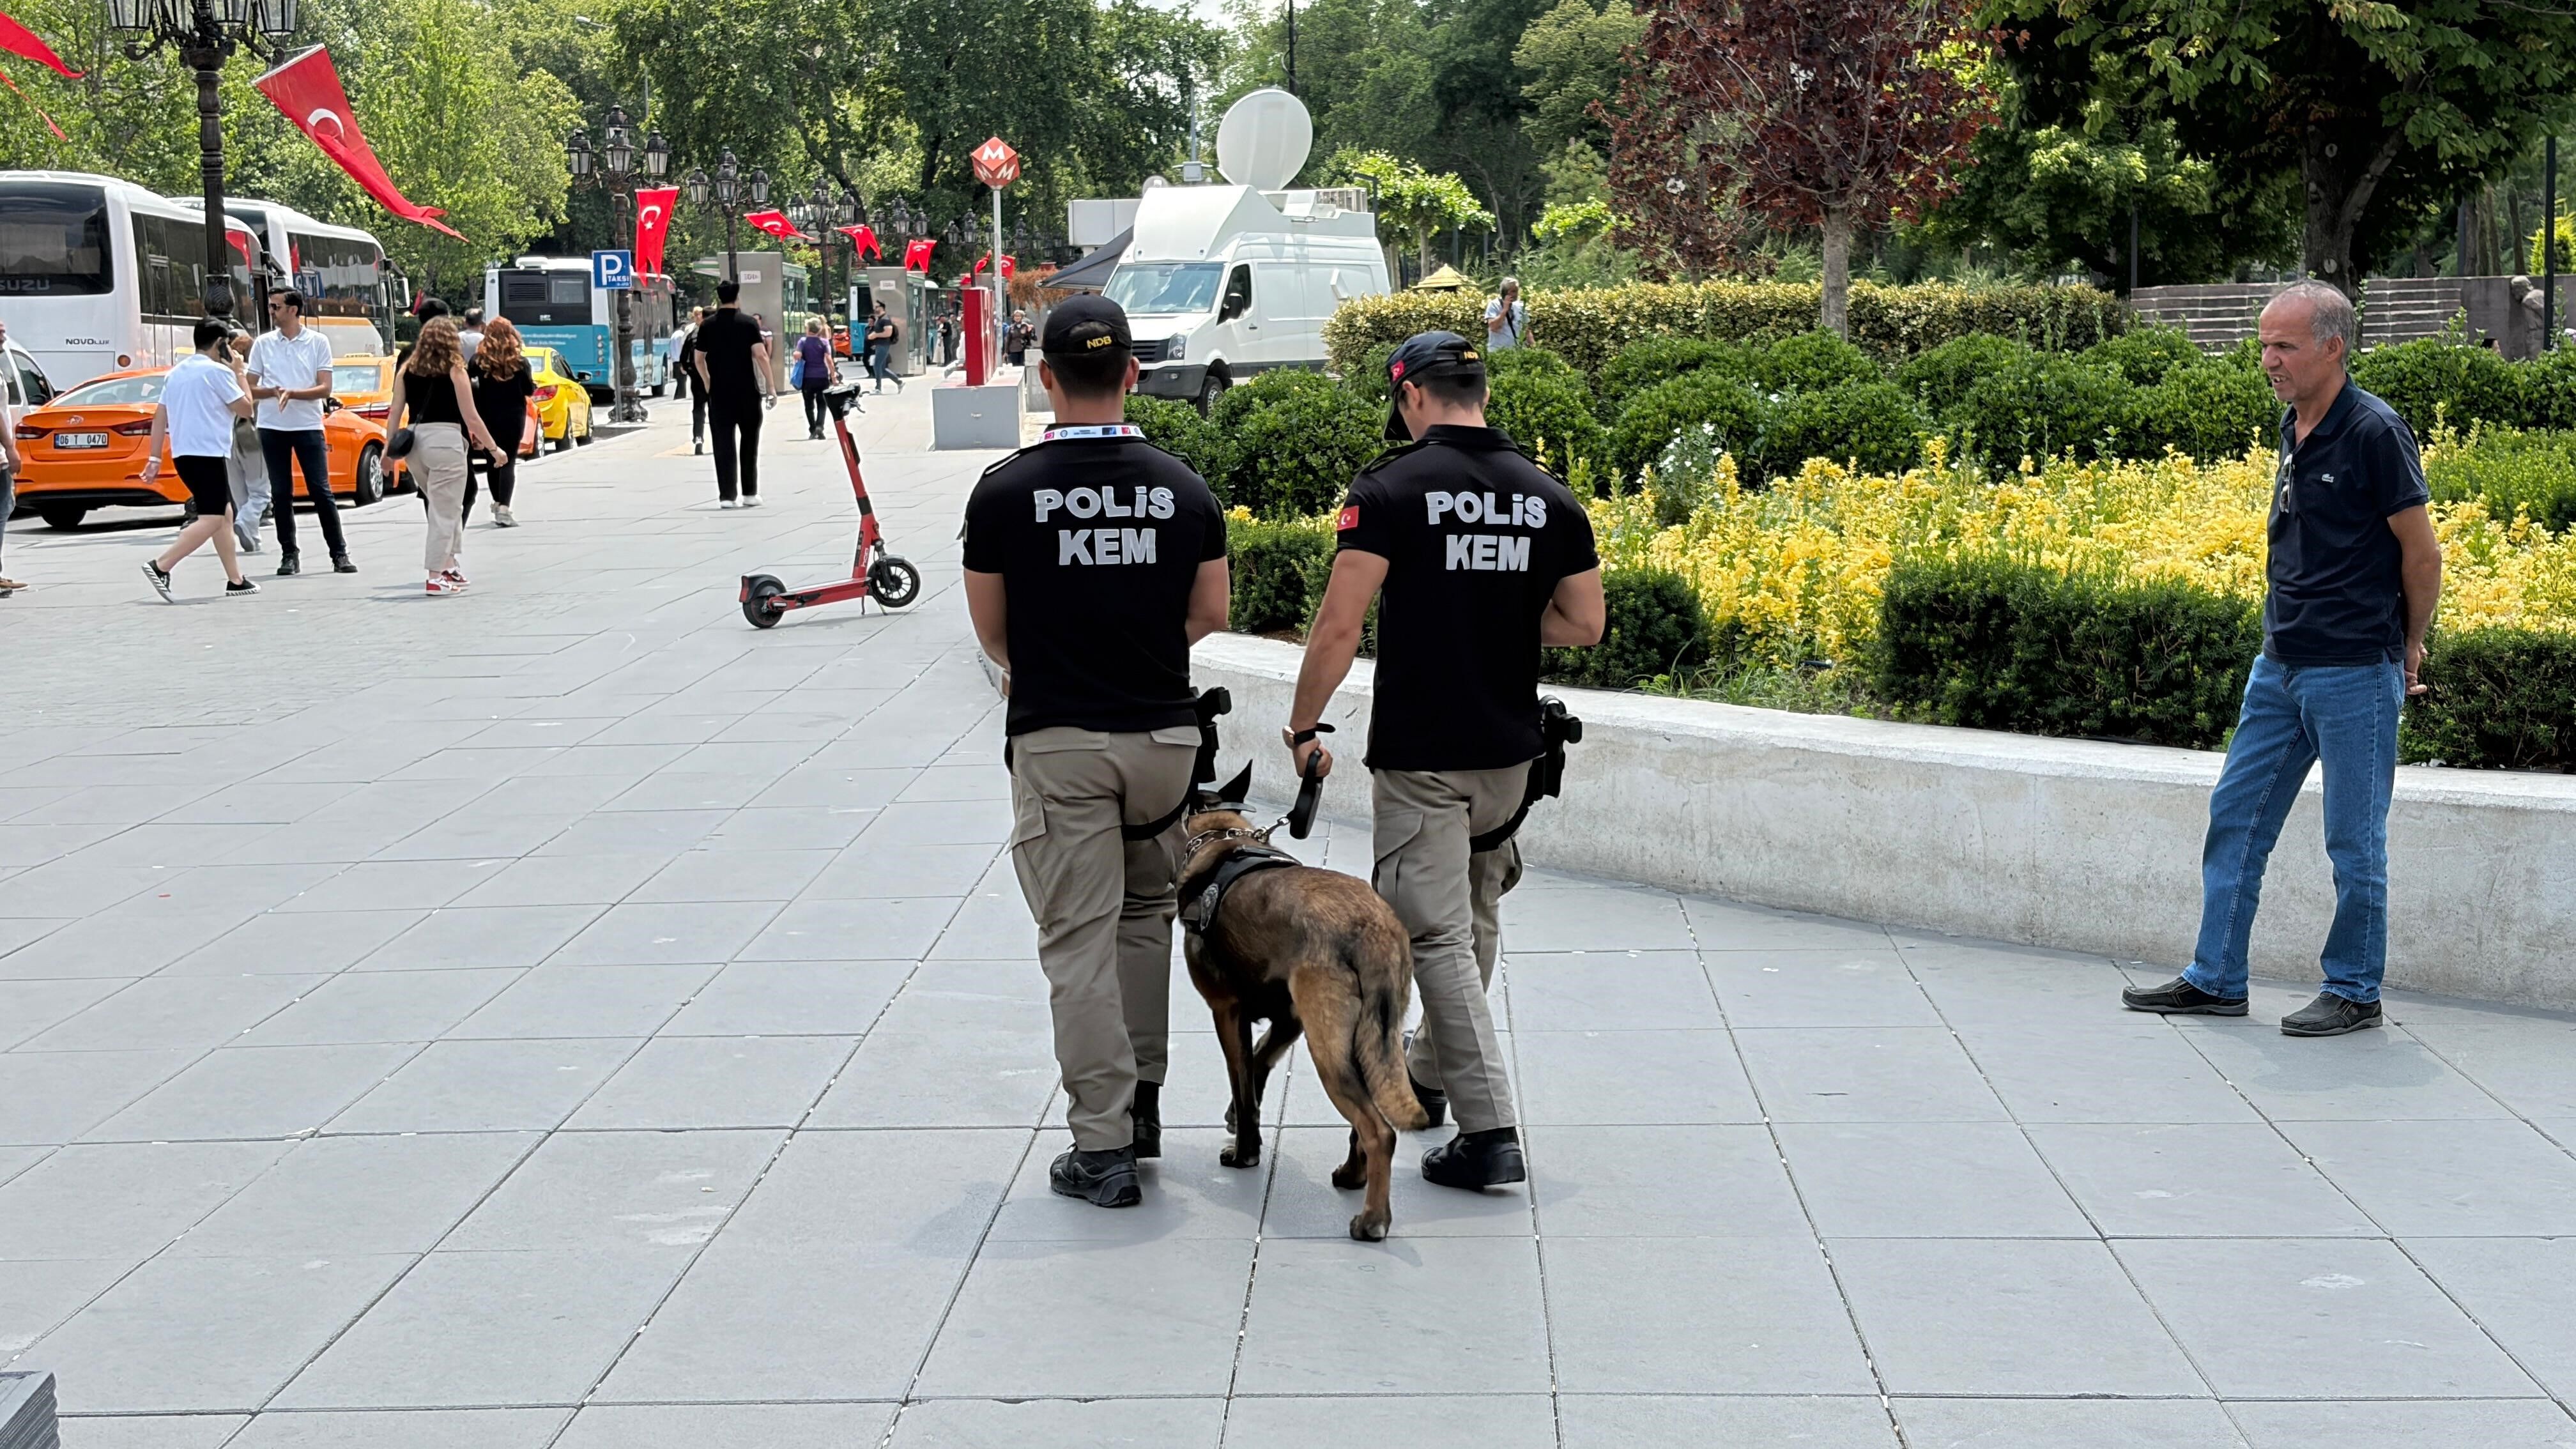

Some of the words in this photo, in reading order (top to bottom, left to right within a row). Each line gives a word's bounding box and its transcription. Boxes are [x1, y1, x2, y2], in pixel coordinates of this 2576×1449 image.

[981, 144, 1006, 160] M
[976, 164, 992, 180] M
[997, 162, 1016, 180] M
[601, 254, 622, 286] P
[1086, 335, 1112, 349] NDB
[60, 435, 69, 445] 06
[74, 435, 78, 445] T
[87, 434, 107, 444] 0470
[1058, 528, 1156, 565] KEM
[1446, 534, 1531, 571] KEM
